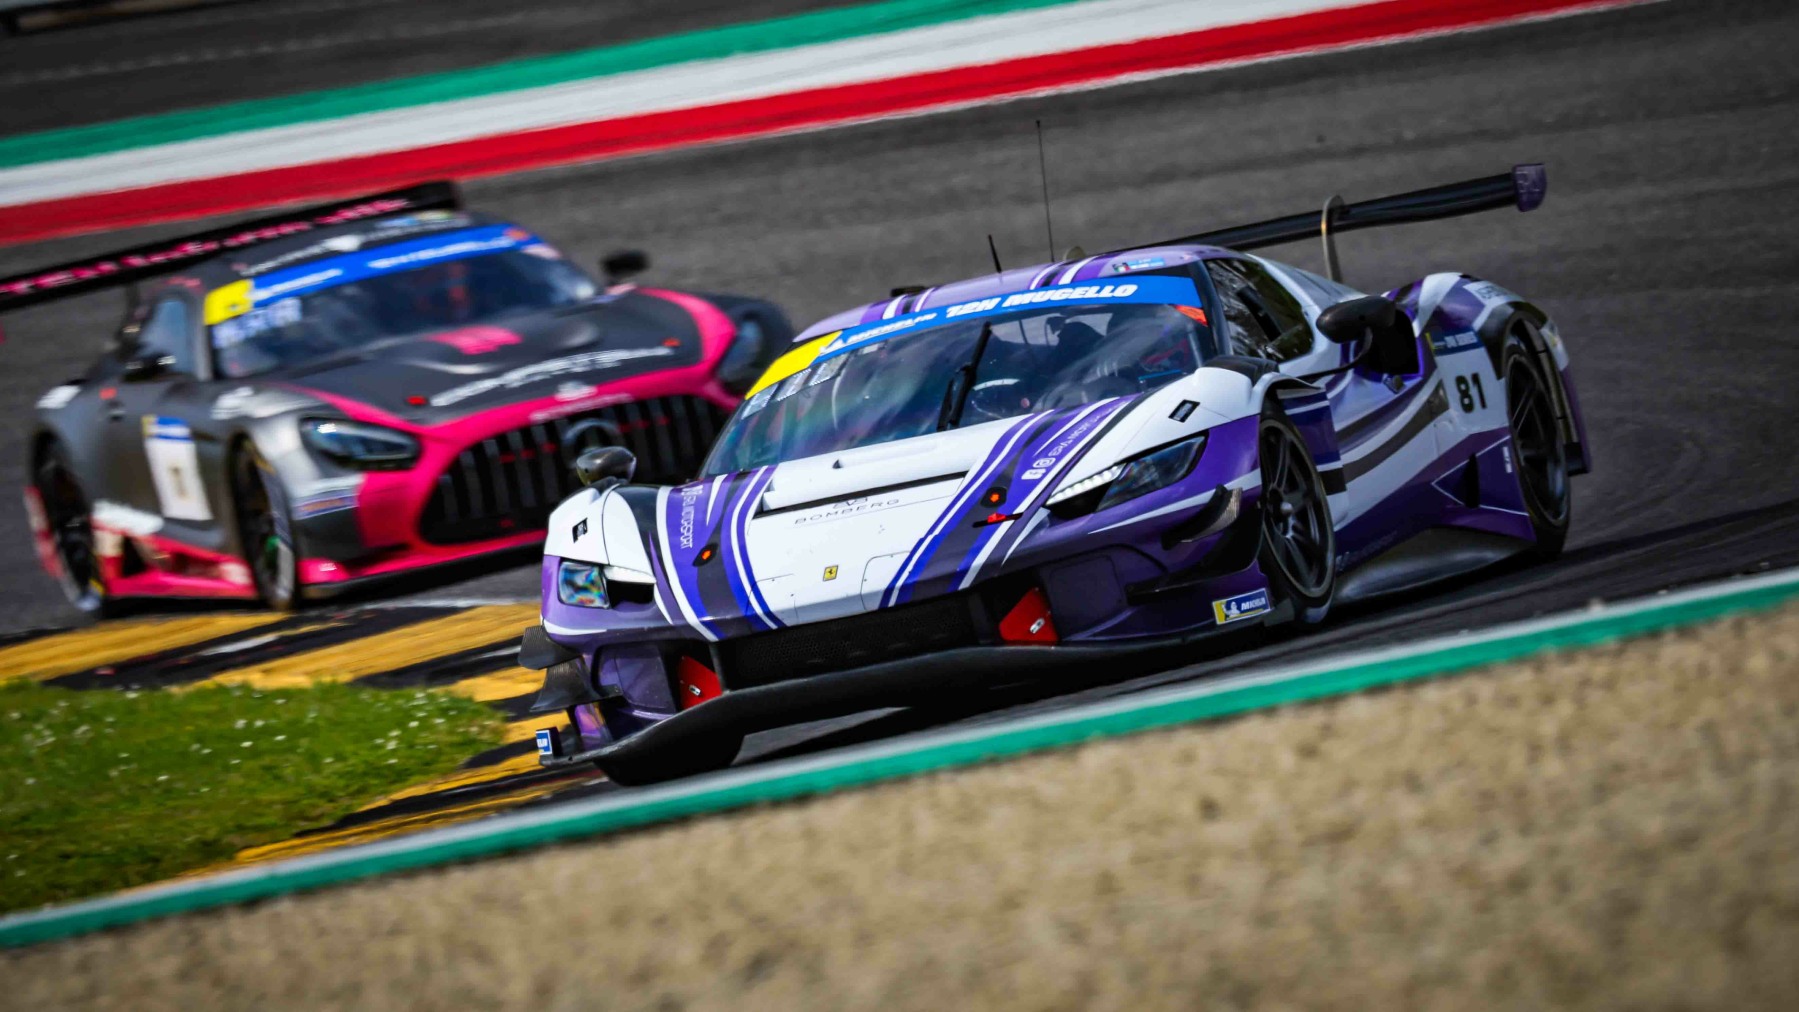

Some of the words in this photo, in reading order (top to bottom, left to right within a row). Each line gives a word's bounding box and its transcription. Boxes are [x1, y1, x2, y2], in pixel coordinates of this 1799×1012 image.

[946, 297, 1002, 318] 12H
[1002, 284, 1138, 308] MUGELLO
[1455, 372, 1488, 414] 81
